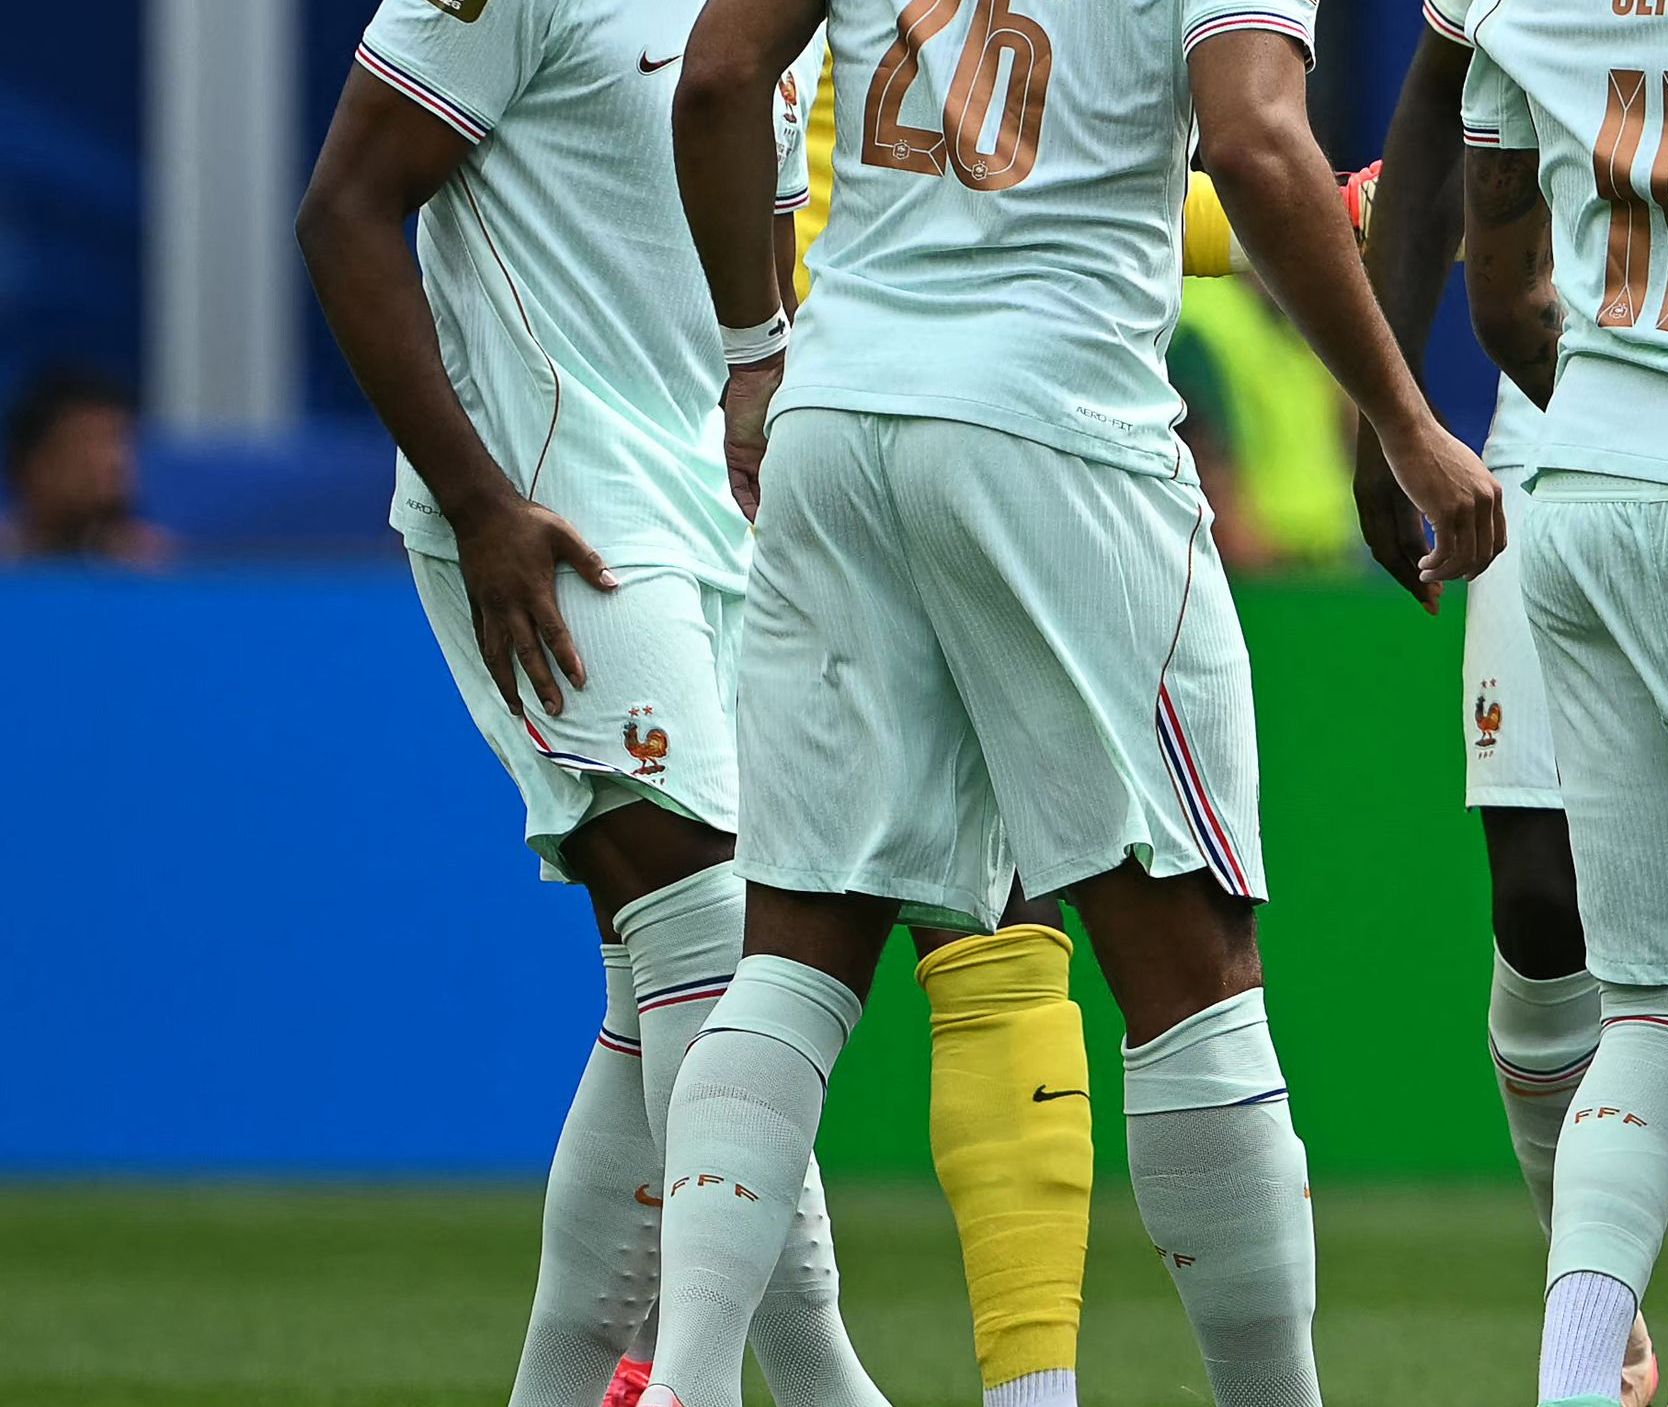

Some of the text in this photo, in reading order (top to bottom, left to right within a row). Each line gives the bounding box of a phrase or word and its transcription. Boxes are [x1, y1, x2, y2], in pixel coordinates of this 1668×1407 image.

[1076, 406, 1134, 432] AERO-FIT
[1575, 1106, 1647, 1128] FFF
[670, 1174, 760, 1202] FFF
